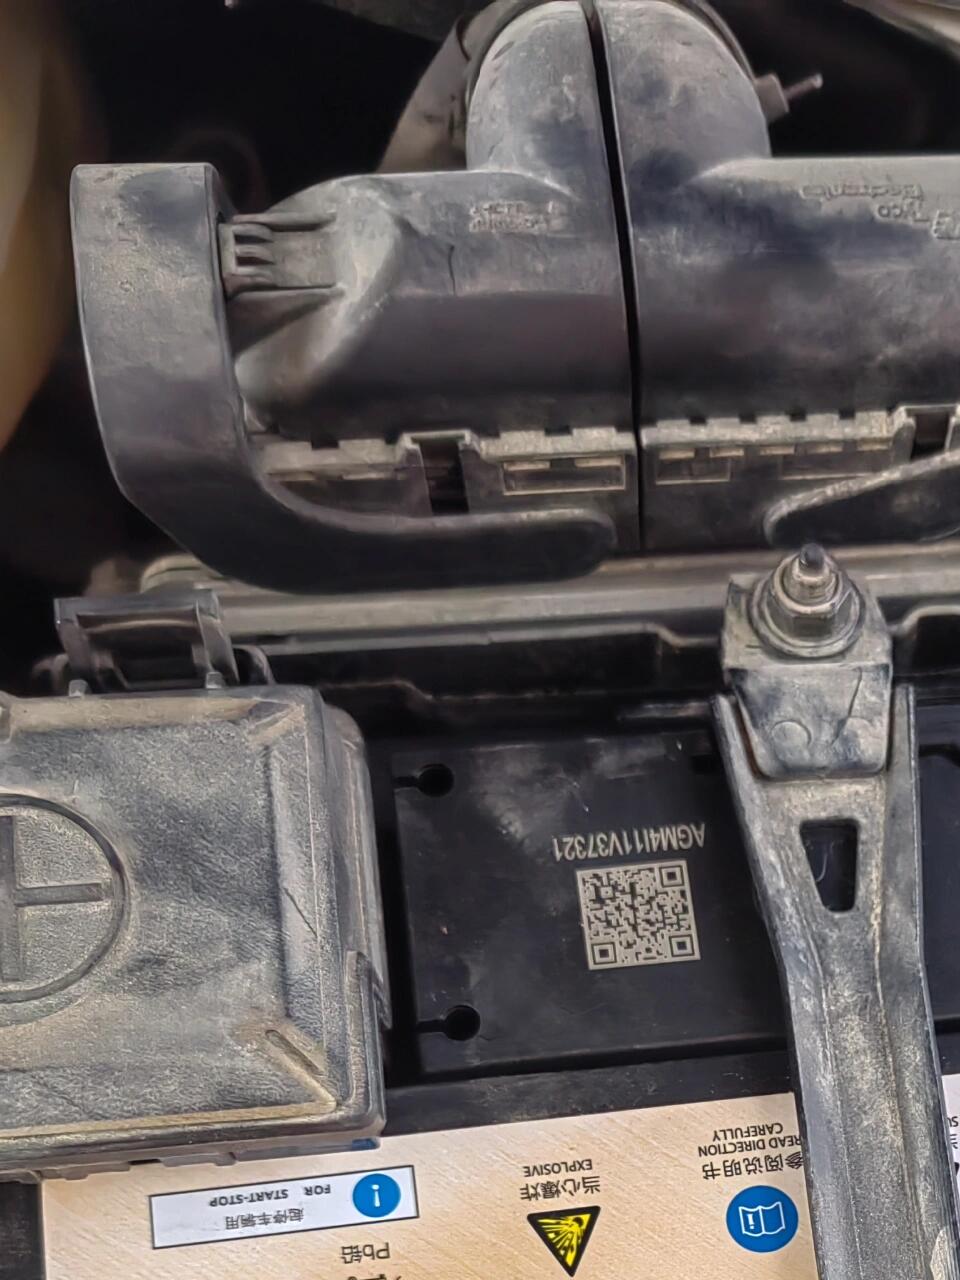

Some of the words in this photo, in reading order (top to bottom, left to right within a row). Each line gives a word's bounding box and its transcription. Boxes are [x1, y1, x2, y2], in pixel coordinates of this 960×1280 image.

[712, 1123, 783, 1141] CAREFULLY
[698, 1139, 765, 1157] DIRECTION
[769, 1135, 801, 1149] READ
[523, 1159, 592, 1177] EXPLOSIVE
[702, 1151, 803, 1180] 参阅说明书
[209, 1188, 288, 1207] START-STOP
[304, 1184, 331, 1196] FOR
[520, 1176, 600, 1201] 当心爆炸
[225, 1207, 304, 1230] 起停车辆用
[341, 1242, 390, 1264] Pb铅
